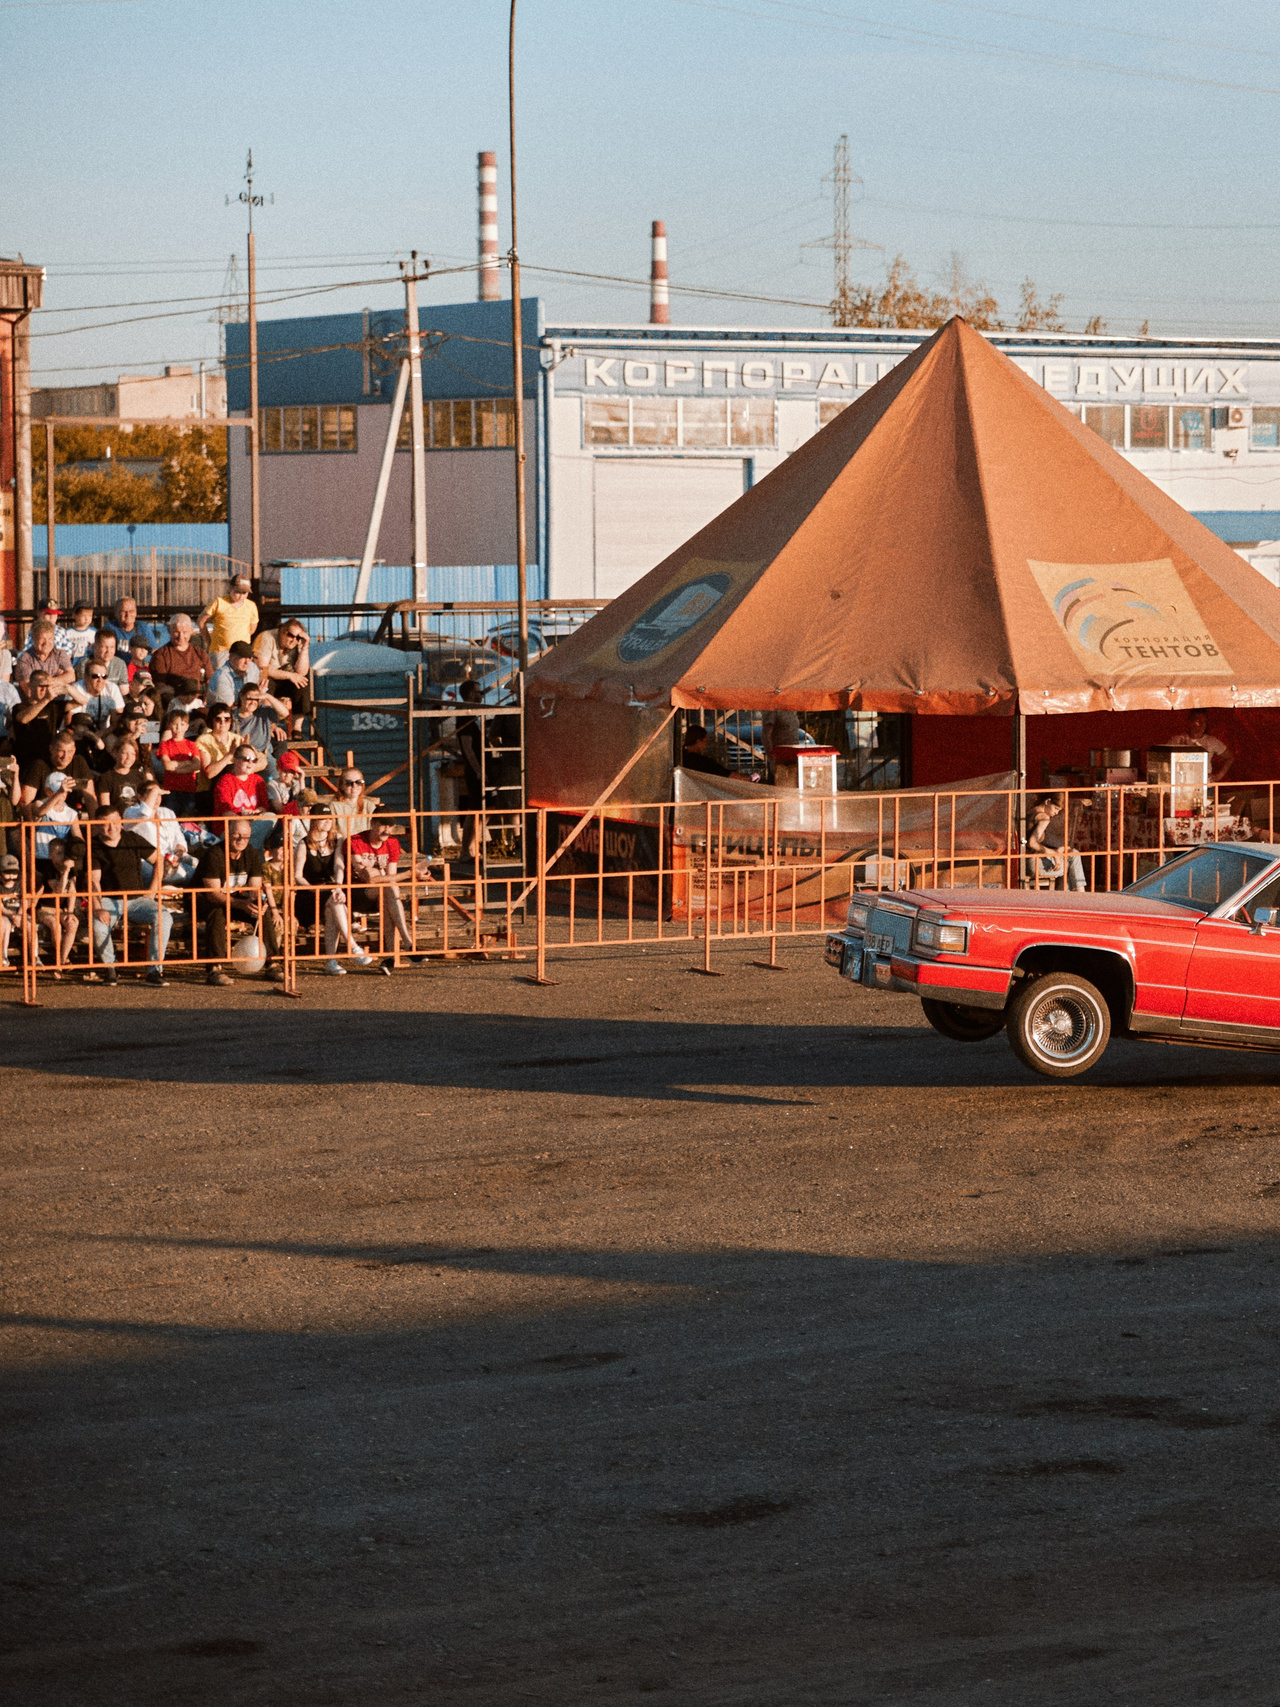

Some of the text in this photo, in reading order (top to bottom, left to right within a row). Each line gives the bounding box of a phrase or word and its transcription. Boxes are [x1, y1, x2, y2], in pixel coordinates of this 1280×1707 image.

[584, 358, 888, 390] КОРПОРАЦ
[1113, 634, 1211, 643] КОРПОРАЦИЯ
[1119, 643, 1219, 658] ТЕНТОВ
[604, 829, 637, 859] ШОУ
